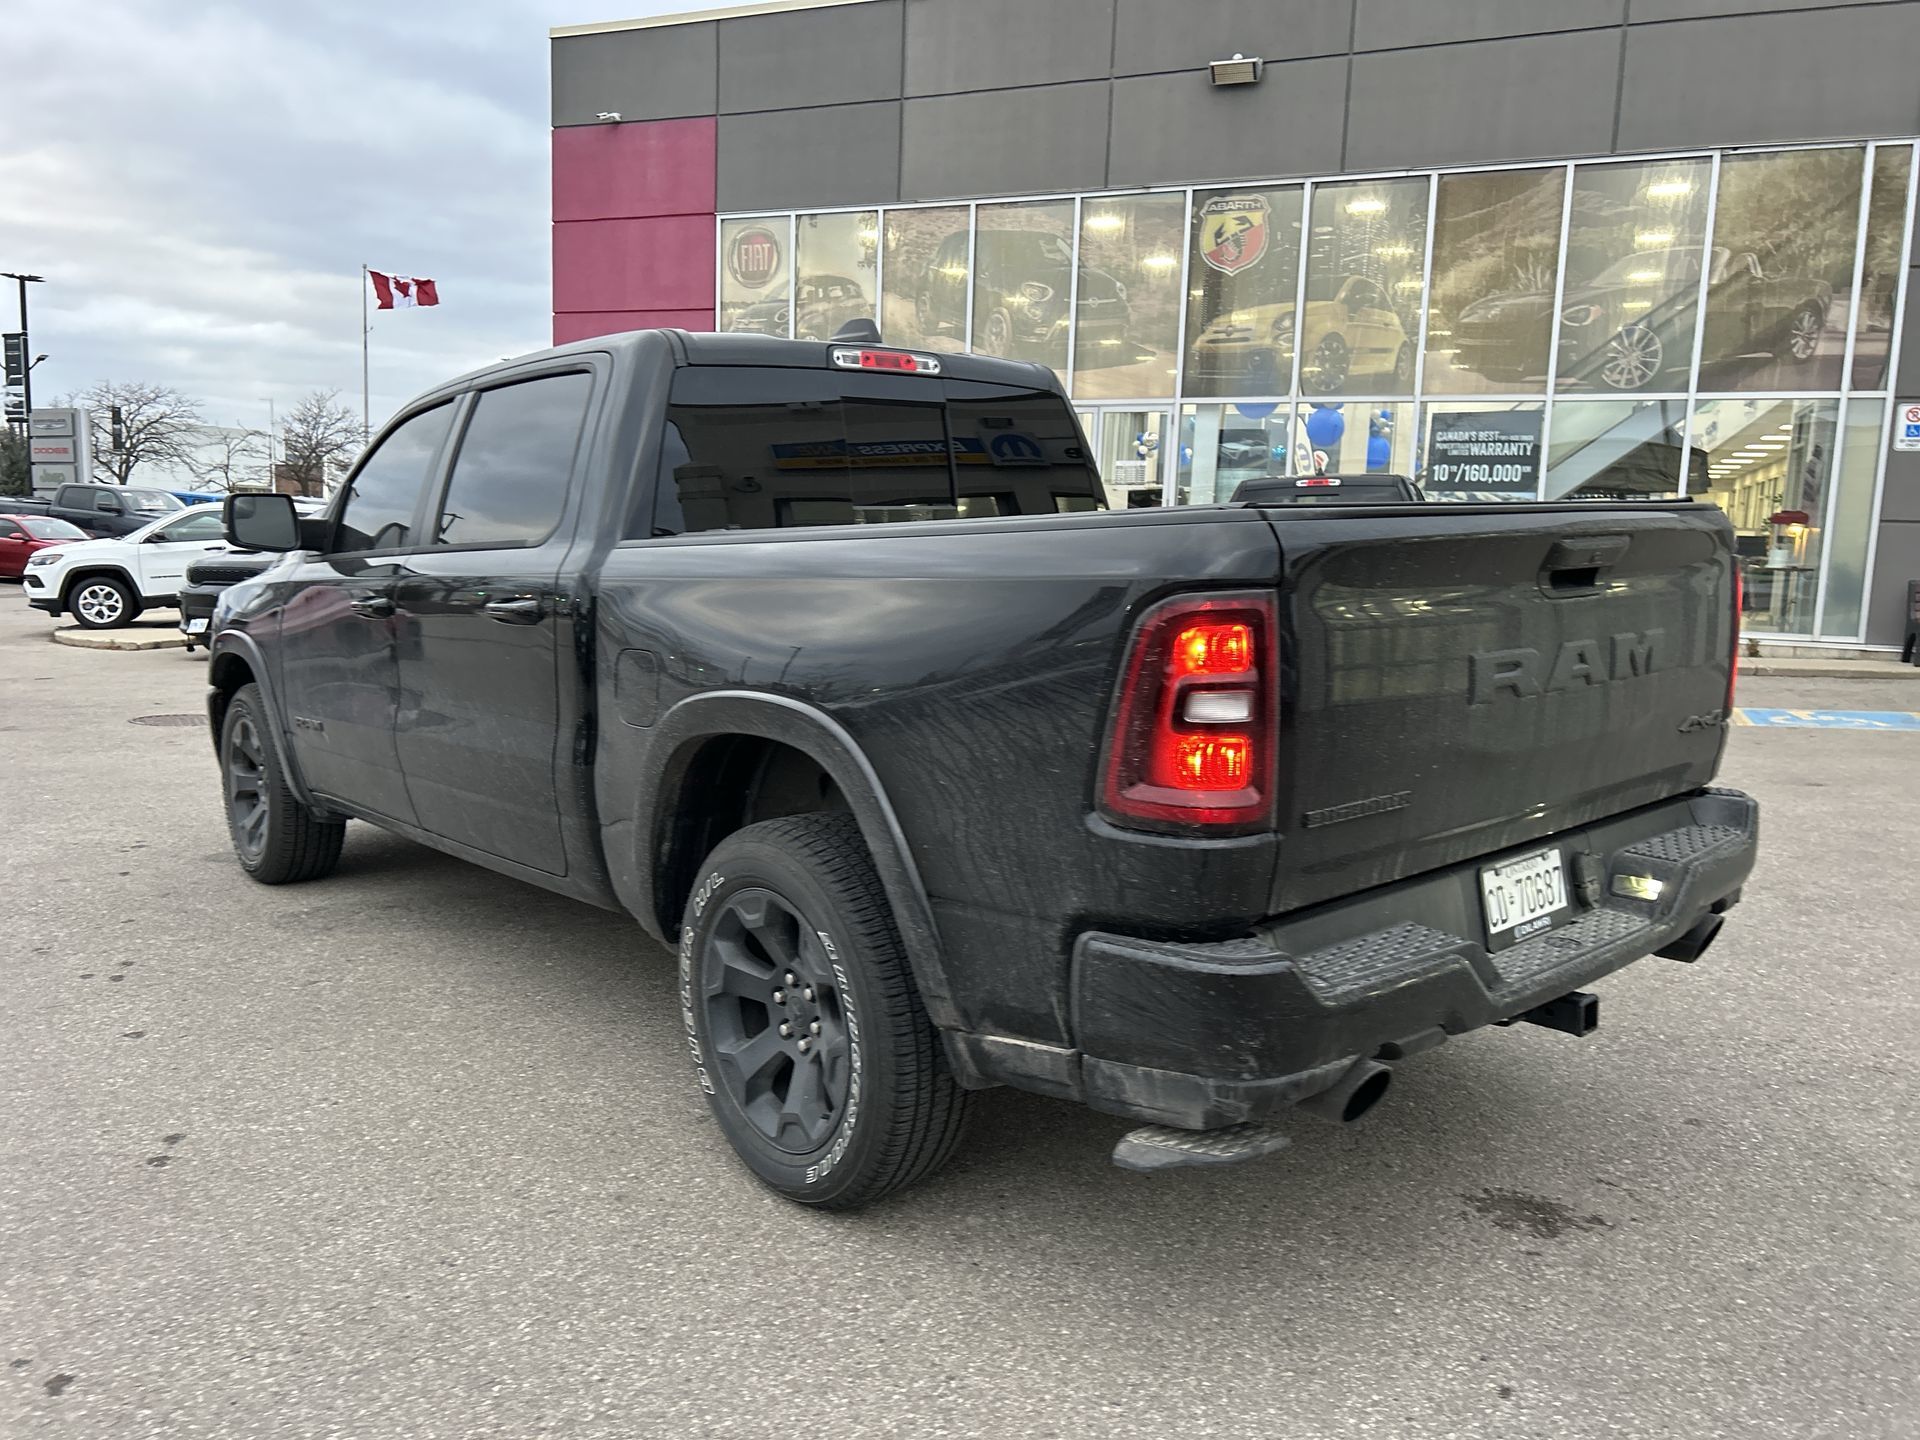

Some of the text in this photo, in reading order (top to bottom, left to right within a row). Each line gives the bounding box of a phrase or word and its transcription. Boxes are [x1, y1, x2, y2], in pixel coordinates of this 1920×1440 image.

[1207, 201, 1261, 212] ABARTH
[741, 243, 771, 272] FIAT
[1436, 431, 1478, 442] CANADA'S
[1478, 430, 1500, 441] BEST
[1470, 442, 1534, 456] WARRANTY
[1467, 627, 1666, 707] RAM
